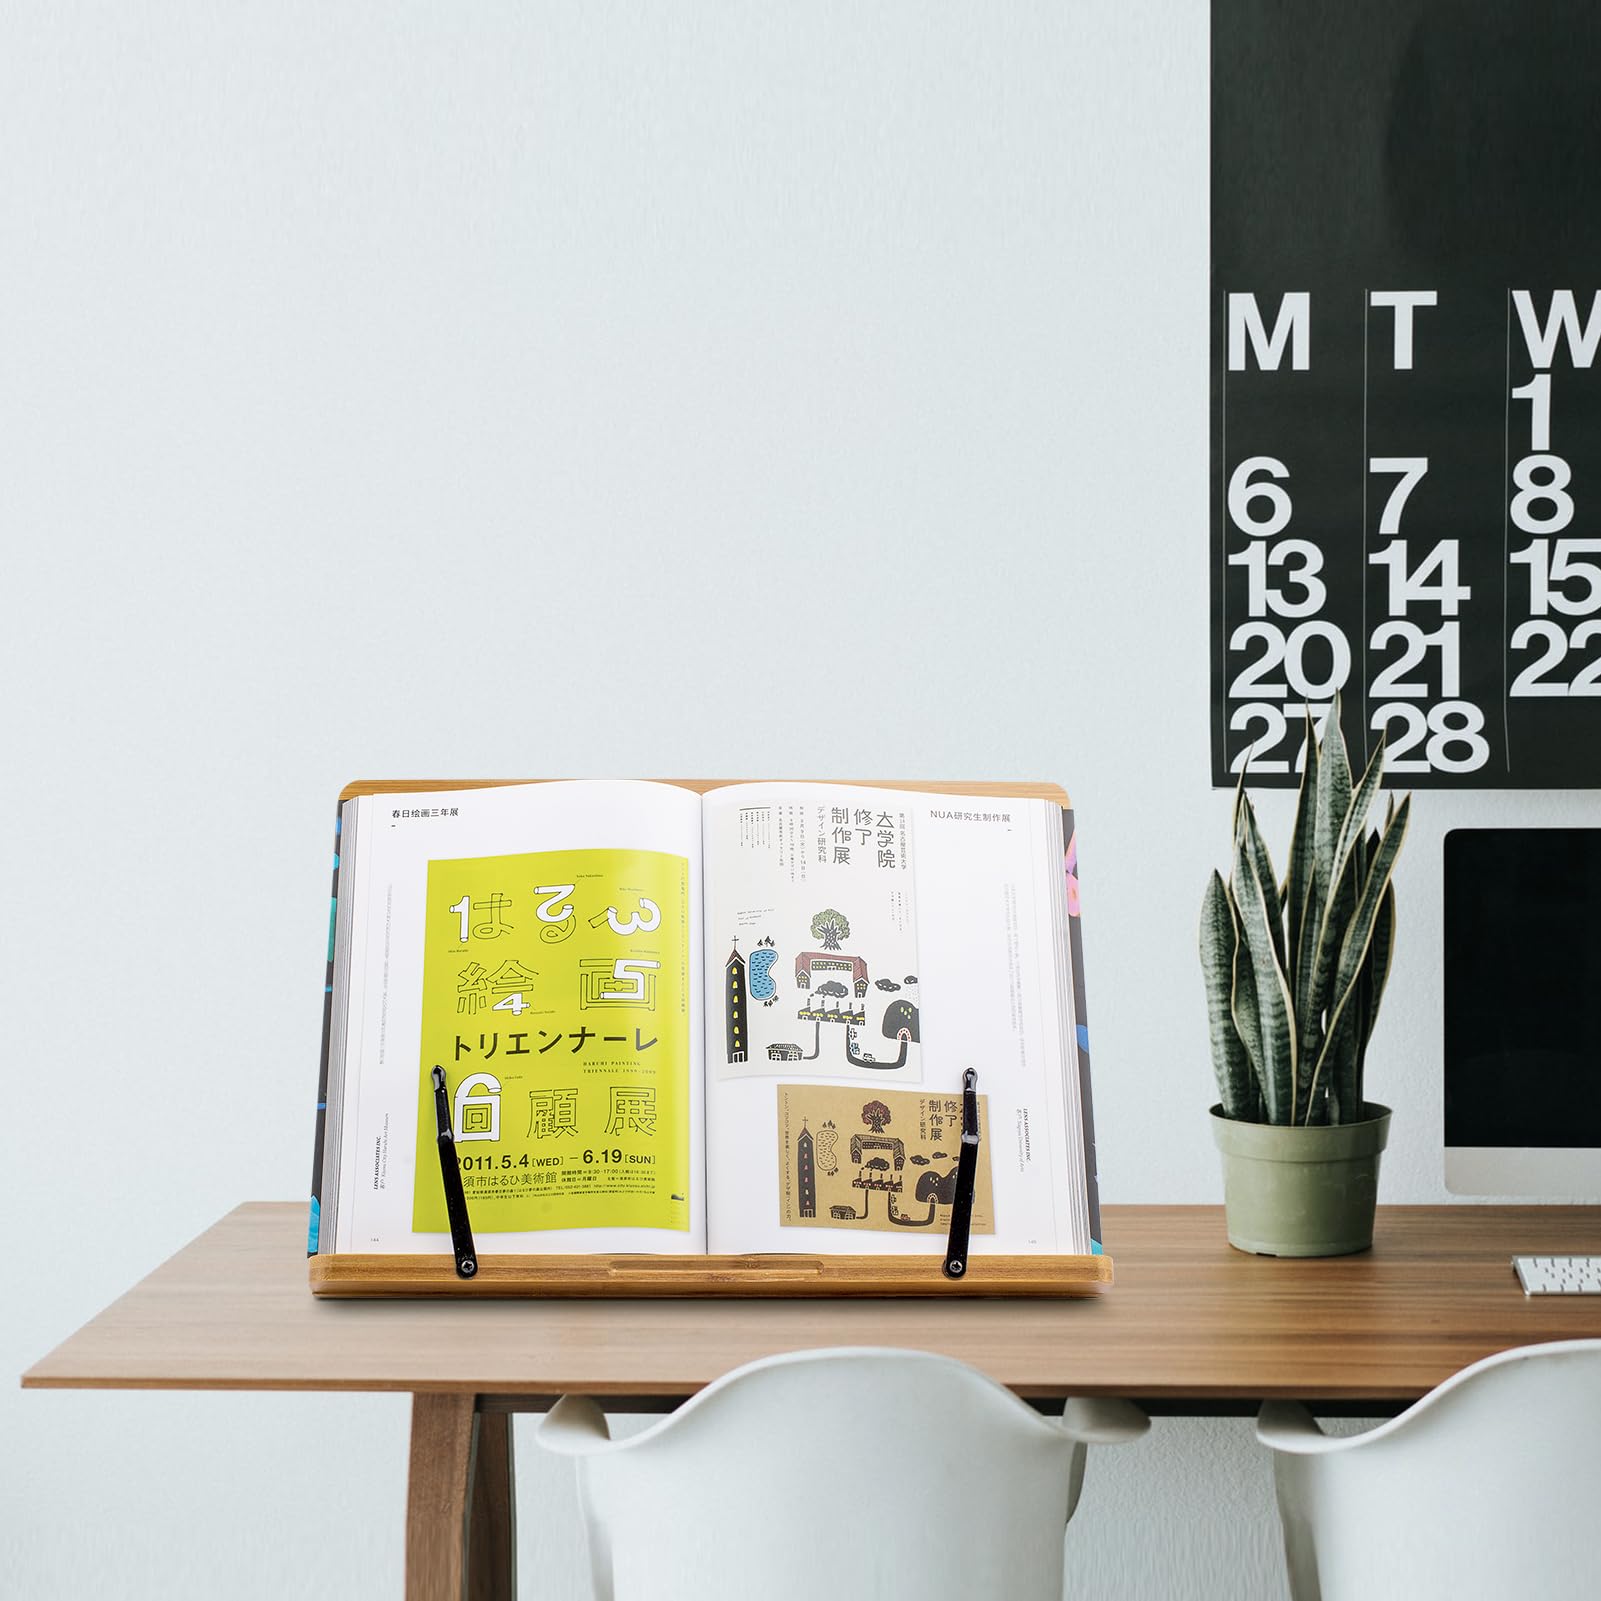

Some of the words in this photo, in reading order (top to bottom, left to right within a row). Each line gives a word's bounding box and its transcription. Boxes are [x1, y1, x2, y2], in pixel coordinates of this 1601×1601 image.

[1228, 292, 1310, 371] M
[1370, 290, 1437, 370] T
[1511, 289, 1601, 369] W
[1511, 373, 1551, 451] 1
[1228, 456, 1292, 537] 6
[1369, 457, 1428, 535] 7
[1510, 454, 1575, 535] 8
[1228, 539, 1327, 618] 13
[1369, 539, 1471, 617] 14
[1510, 538, 1601, 616] 15
[1228, 620, 1351, 700] 20
[1369, 620, 1460, 698] 21
[1509, 618, 1601, 698] 22
[1370, 700, 1490, 774] 28
[392, 808, 459, 818] 春日绘画三年展
[831, 807, 852, 865] 制作展
[853, 808, 873, 846] 修了
[930, 810, 1011, 822] NUA研究生制作展
[455, 1026, 658, 1061] トリエンナーレ
[929, 1100, 943, 1141] 制作展
[944, 1100, 958, 1127] 修了
[583, 1149, 622, 1164] 6.19
